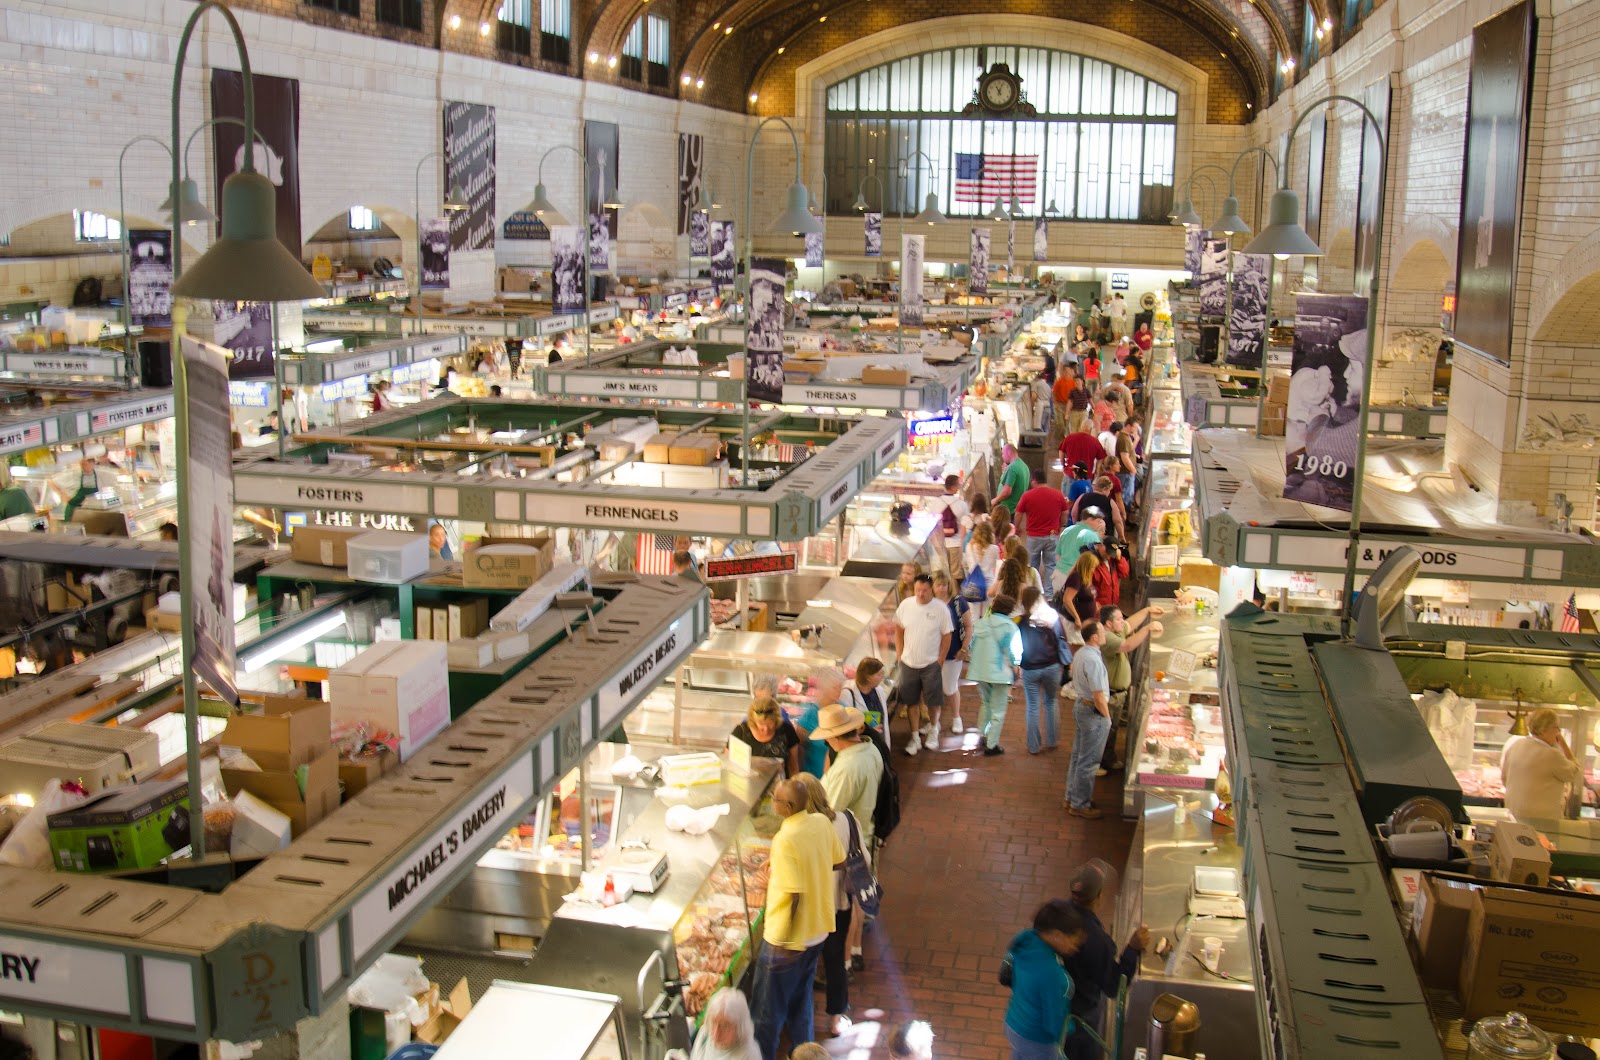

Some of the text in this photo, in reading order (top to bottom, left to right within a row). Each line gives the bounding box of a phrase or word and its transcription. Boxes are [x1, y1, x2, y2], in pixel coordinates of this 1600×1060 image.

[1112, 273, 1129, 282] ATM
[231, 346, 265, 364] 917
[1232, 339, 1259, 354] 1977
[33, 360, 88, 371] VINCE'S MEATS
[603, 383, 658, 392] JIM'S MEATS
[804, 390, 857, 401] THERESA'S
[109, 402, 168, 422] FOSTER'S MEATS
[1294, 453, 1348, 480] 1980
[297, 486, 364, 503] FOSTER'S
[585, 504, 679, 522] FERNENGELS
[1217, 526, 1229, 542] C
[1217, 545, 1227, 560] 4
[1363, 549, 1374, 561] &
[1421, 551, 1457, 566] ODS
[709, 556, 793, 577] FERNENGELS
[619, 633, 677, 698] WALKER'S MEATS
[388, 784, 507, 912] MICHAEL'S BAKERY
[1488, 923, 1535, 940] No. L24C
[0, 954, 41, 984] RY
[242, 950, 276, 984] D
[254, 994, 274, 1023] 2
